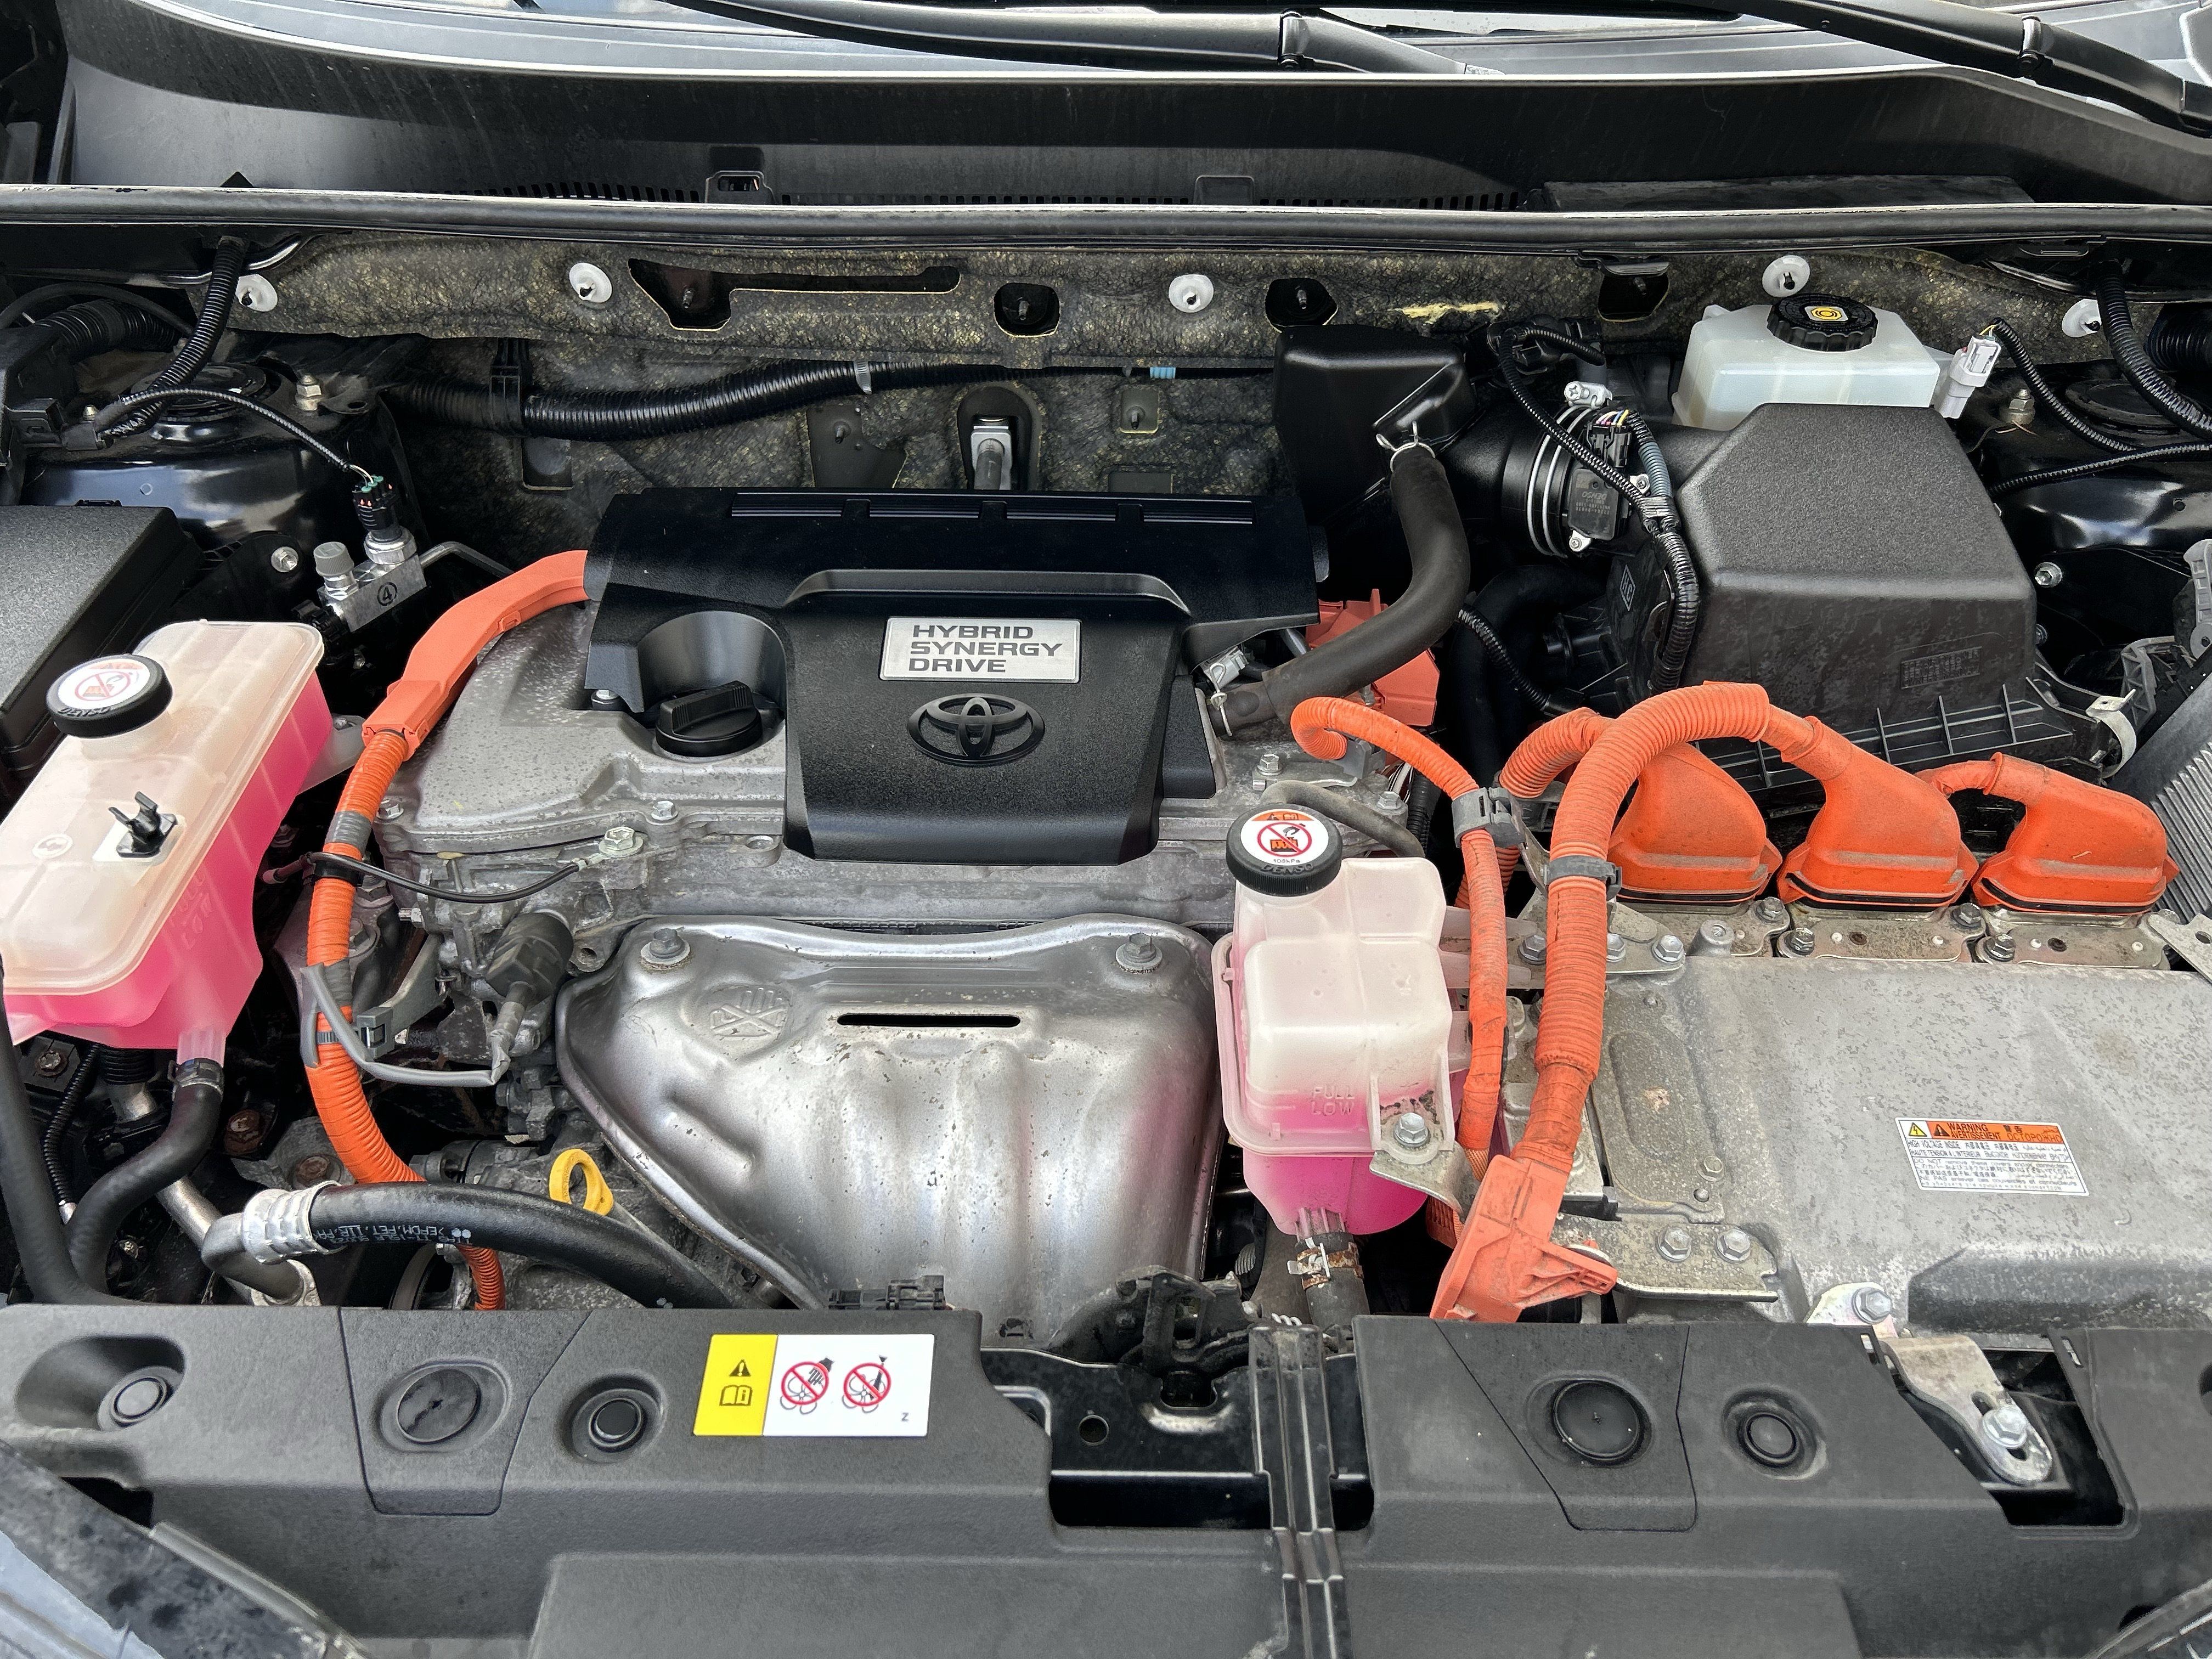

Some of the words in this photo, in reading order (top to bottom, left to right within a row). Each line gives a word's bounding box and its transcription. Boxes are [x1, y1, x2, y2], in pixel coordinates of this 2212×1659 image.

[1582, 492, 1607, 500] DENSO
[913, 625, 1033, 639] HYBRID
[911, 641, 1063, 656] SYNERGY
[909, 658, 1006, 673] DRIVE
[58, 707, 111, 718] DENSO
[1261, 863, 1314, 876] DENSO
[1312, 1085, 1355, 1099] FULL
[1311, 1101, 1355, 1115] LOW
[1946, 1123, 1989, 1131] WARNING
[1950, 1131, 2002, 1139] AVERTISSEMENT
[1920, 1139, 1943, 1148] VOLTAGE
[1944, 1141, 1961, 1149] INSIDE
